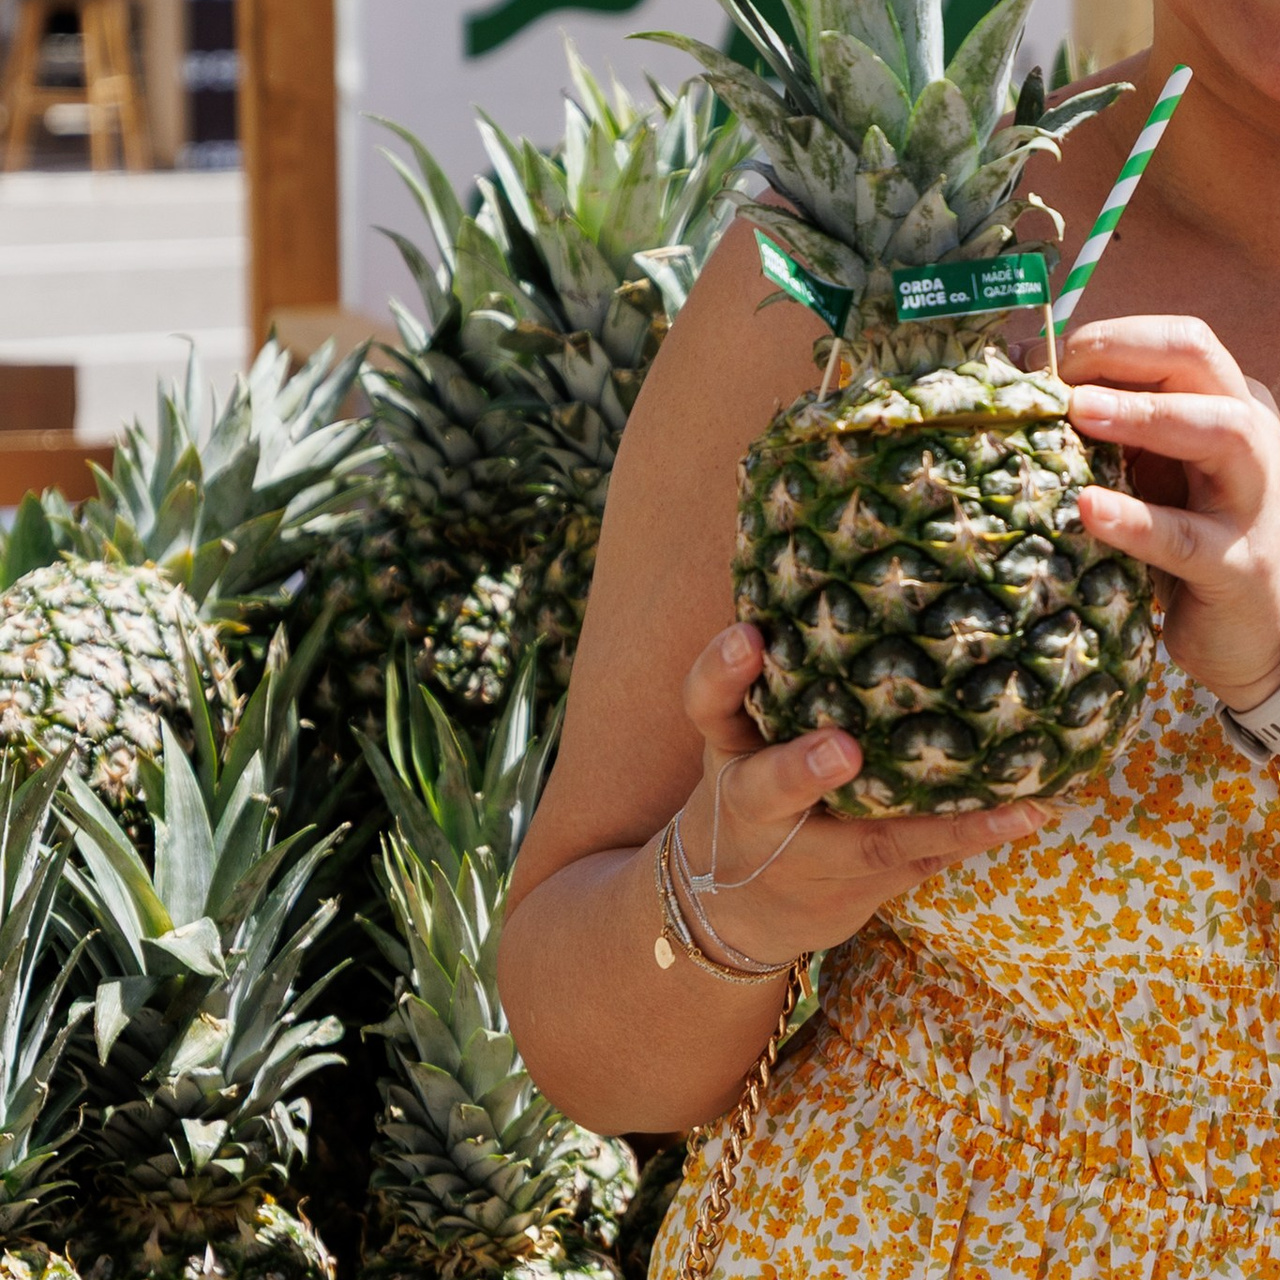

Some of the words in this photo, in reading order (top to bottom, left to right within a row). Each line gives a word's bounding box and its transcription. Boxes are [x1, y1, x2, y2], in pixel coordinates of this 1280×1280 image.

[981, 268, 1012, 283] MADE
[1014, 267, 1025, 280] IN
[899, 277, 944, 295] ORDA
[902, 291, 947, 310] JUICE
